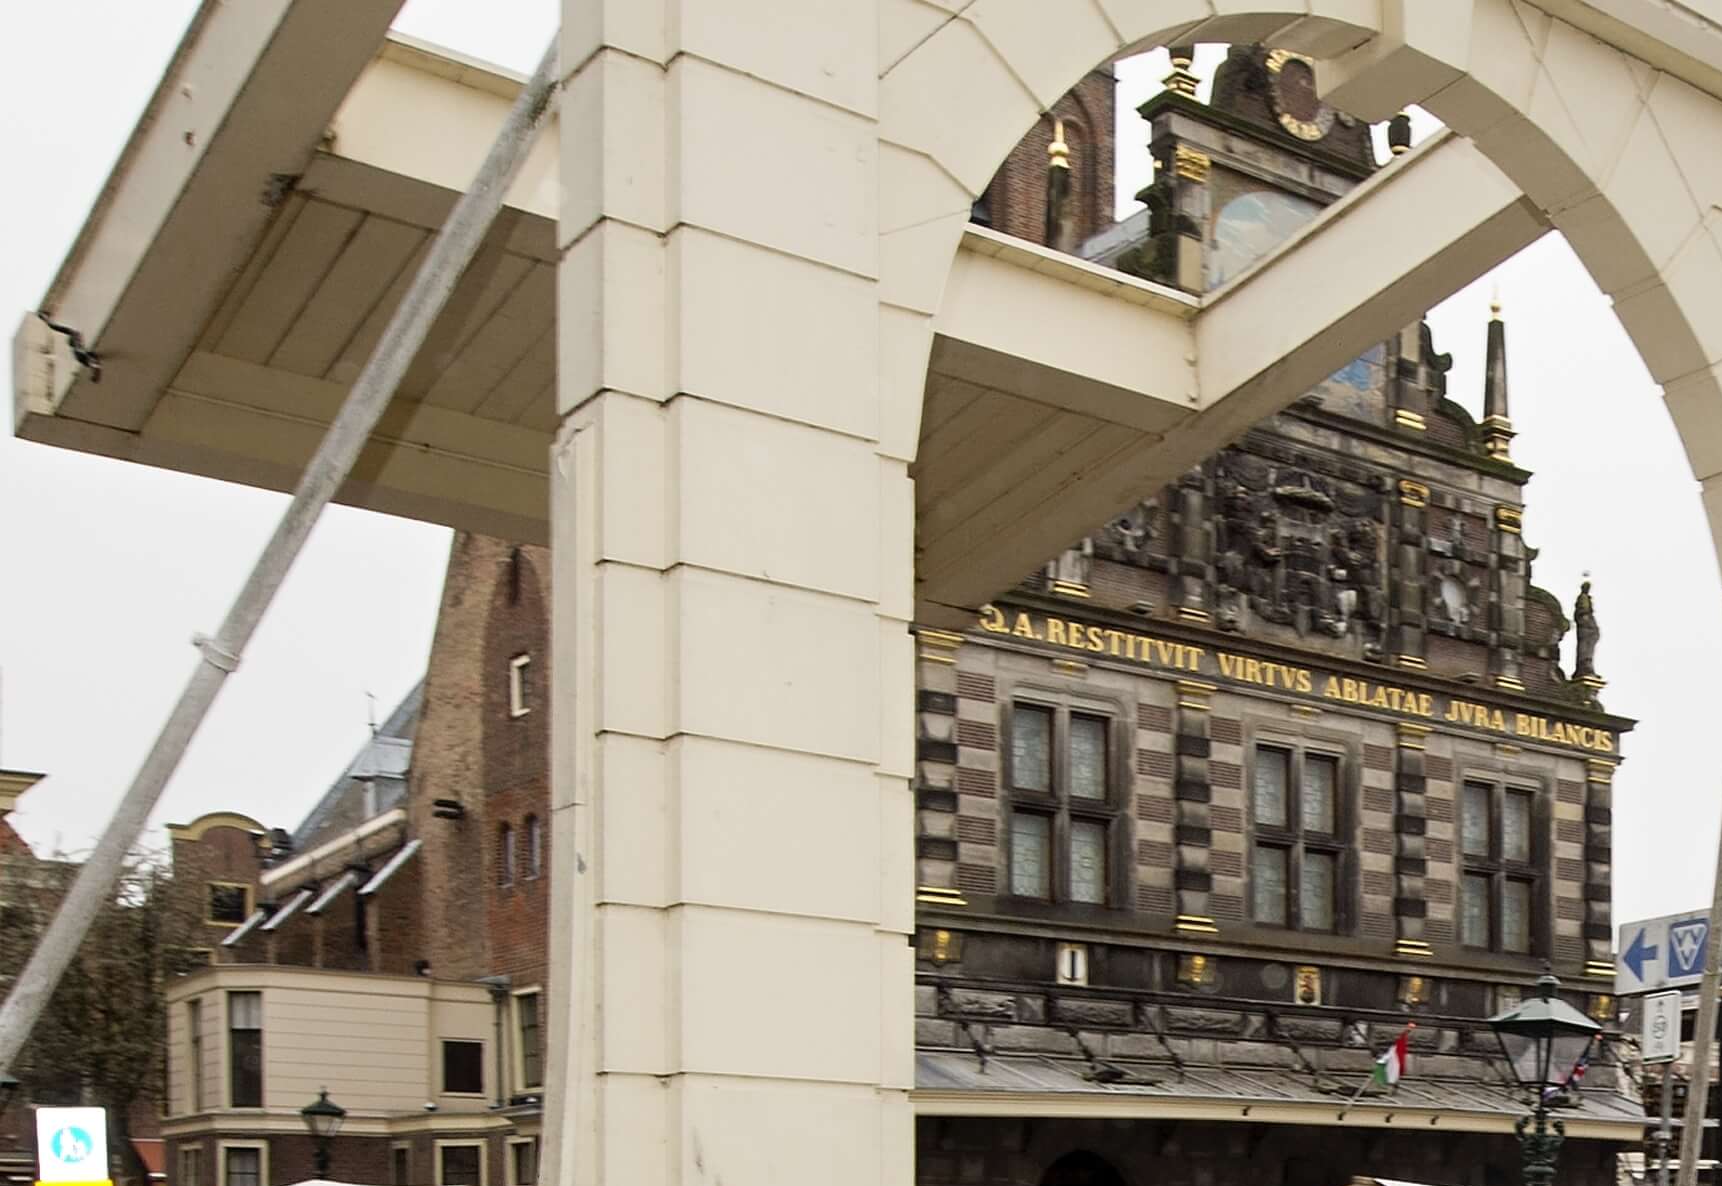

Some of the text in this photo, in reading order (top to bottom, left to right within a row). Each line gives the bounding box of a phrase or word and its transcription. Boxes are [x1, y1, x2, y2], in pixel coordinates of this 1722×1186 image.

[1217, 652, 1312, 693] VIRTVS
[1323, 676, 1433, 717] ABLATAE
[1515, 713, 1613, 752] BILANCIS
